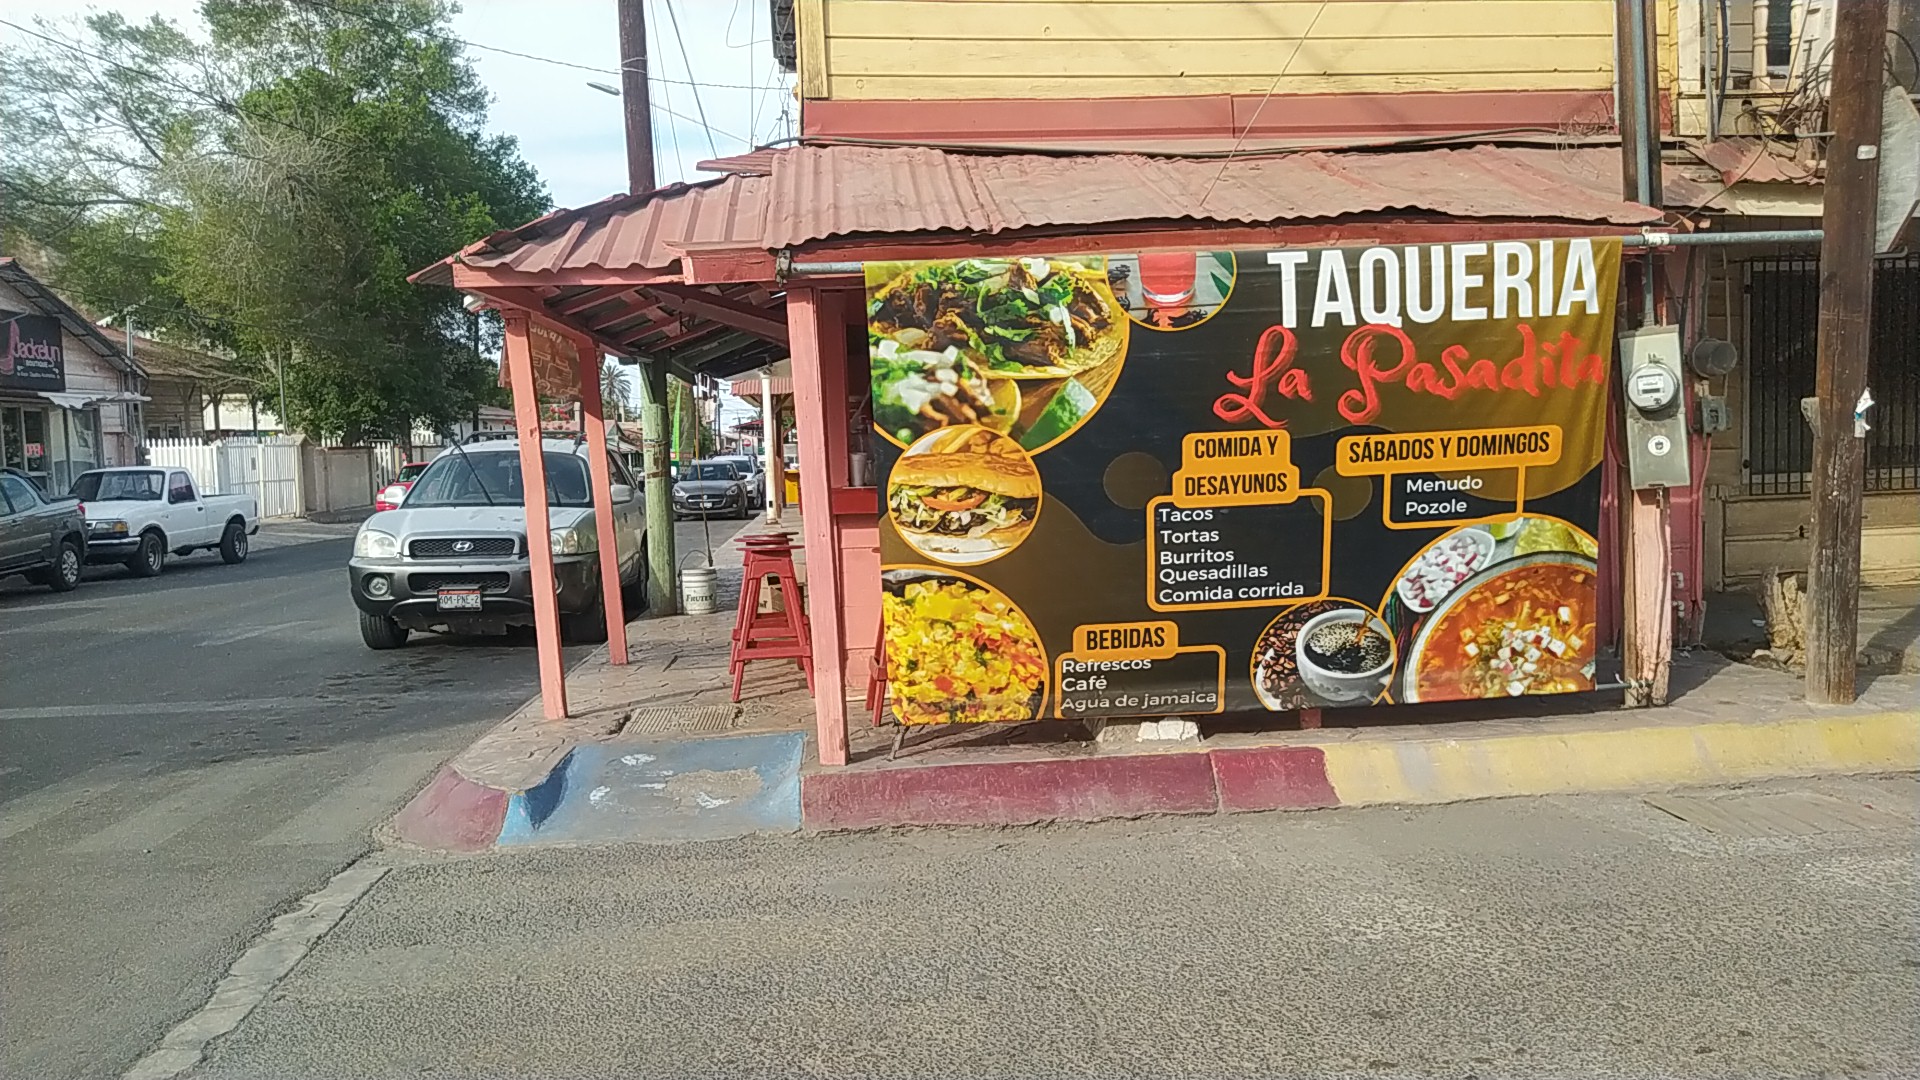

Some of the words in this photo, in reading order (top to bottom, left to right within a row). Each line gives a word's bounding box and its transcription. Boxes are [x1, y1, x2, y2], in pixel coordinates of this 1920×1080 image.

[1267, 239, 1600, 329] TAQUERIA
[1213, 325, 1314, 428] La
[1337, 323, 1605, 425] Pasadita
[1194, 436, 1262, 458] COMIDA
[1267, 435, 1279, 456] Y
[1348, 437, 1434, 464] SÁBADOS
[1440, 437, 1452, 458] Y
[1456, 431, 1550, 457] DOMINGOS
[1184, 472, 1288, 496] DESAYUNOS
[1406, 475, 1483, 494] Menudo
[1158, 508, 1214, 523] Tacos
[1405, 499, 1468, 516] Pozole
[1160, 529, 1220, 544] Tortas
[1160, 548, 1235, 565] Burritos
[1159, 563, 1269, 585] Quesadillas
[1159, 585, 1233, 603] Comida
[1238, 581, 1304, 599] corrida
[1086, 627, 1165, 651] BEBIDAS
[1062, 658, 1152, 674] Refrescos
[1061, 674, 1108, 692] Café
[1061, 696, 1110, 712] Agua
[1114, 694, 1139, 708] de
[1141, 690, 1217, 709] jamaica
